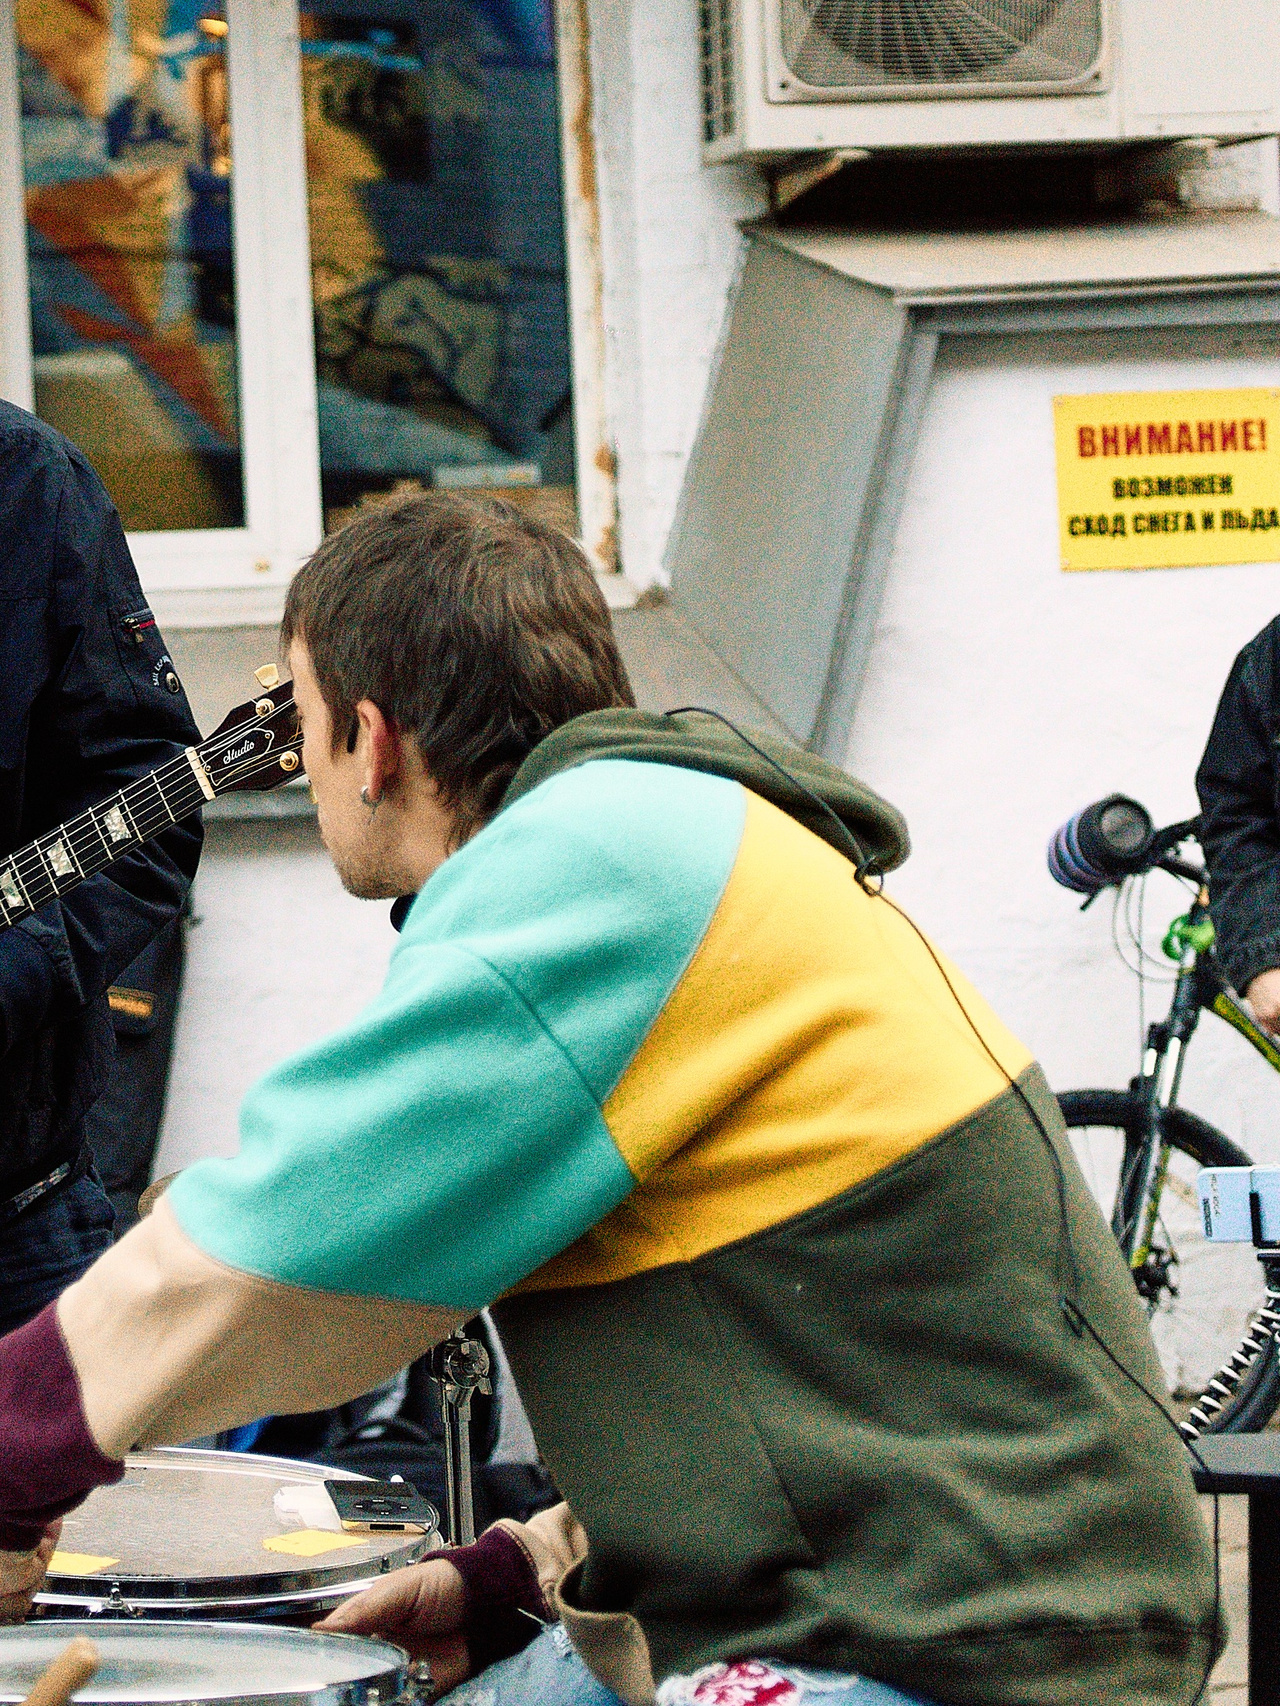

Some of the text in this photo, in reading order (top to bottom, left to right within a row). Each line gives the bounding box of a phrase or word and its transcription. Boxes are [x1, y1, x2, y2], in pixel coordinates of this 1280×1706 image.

[1077, 417, 1267, 458] ВНИМАНИЕ!
[1113, 474, 1232, 499] ВОЗМОЖЕН
[1069, 508, 1280, 537] СХОД СНЕГА И ЛЬДА
[223, 740, 255, 765] Studio
